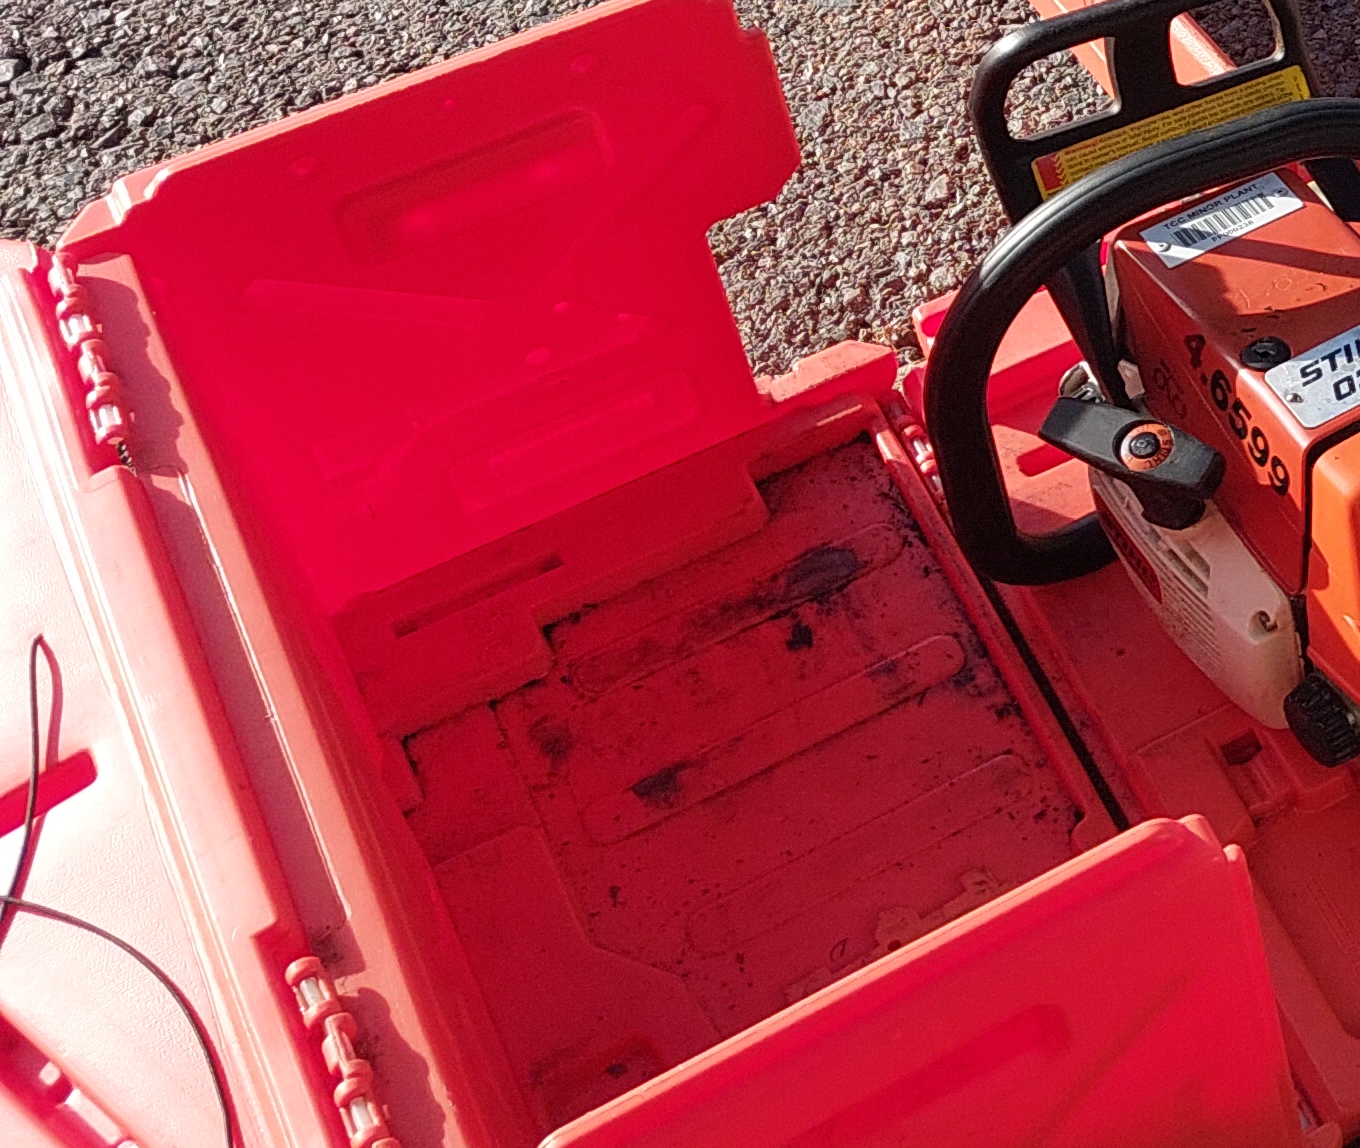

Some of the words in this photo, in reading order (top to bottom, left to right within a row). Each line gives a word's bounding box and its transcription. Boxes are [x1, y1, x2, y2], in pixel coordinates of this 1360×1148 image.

[1163, 215, 1186, 231] TCC
[1187, 200, 1224, 220] MINOR
[1224, 184, 1260, 203] PLANT
